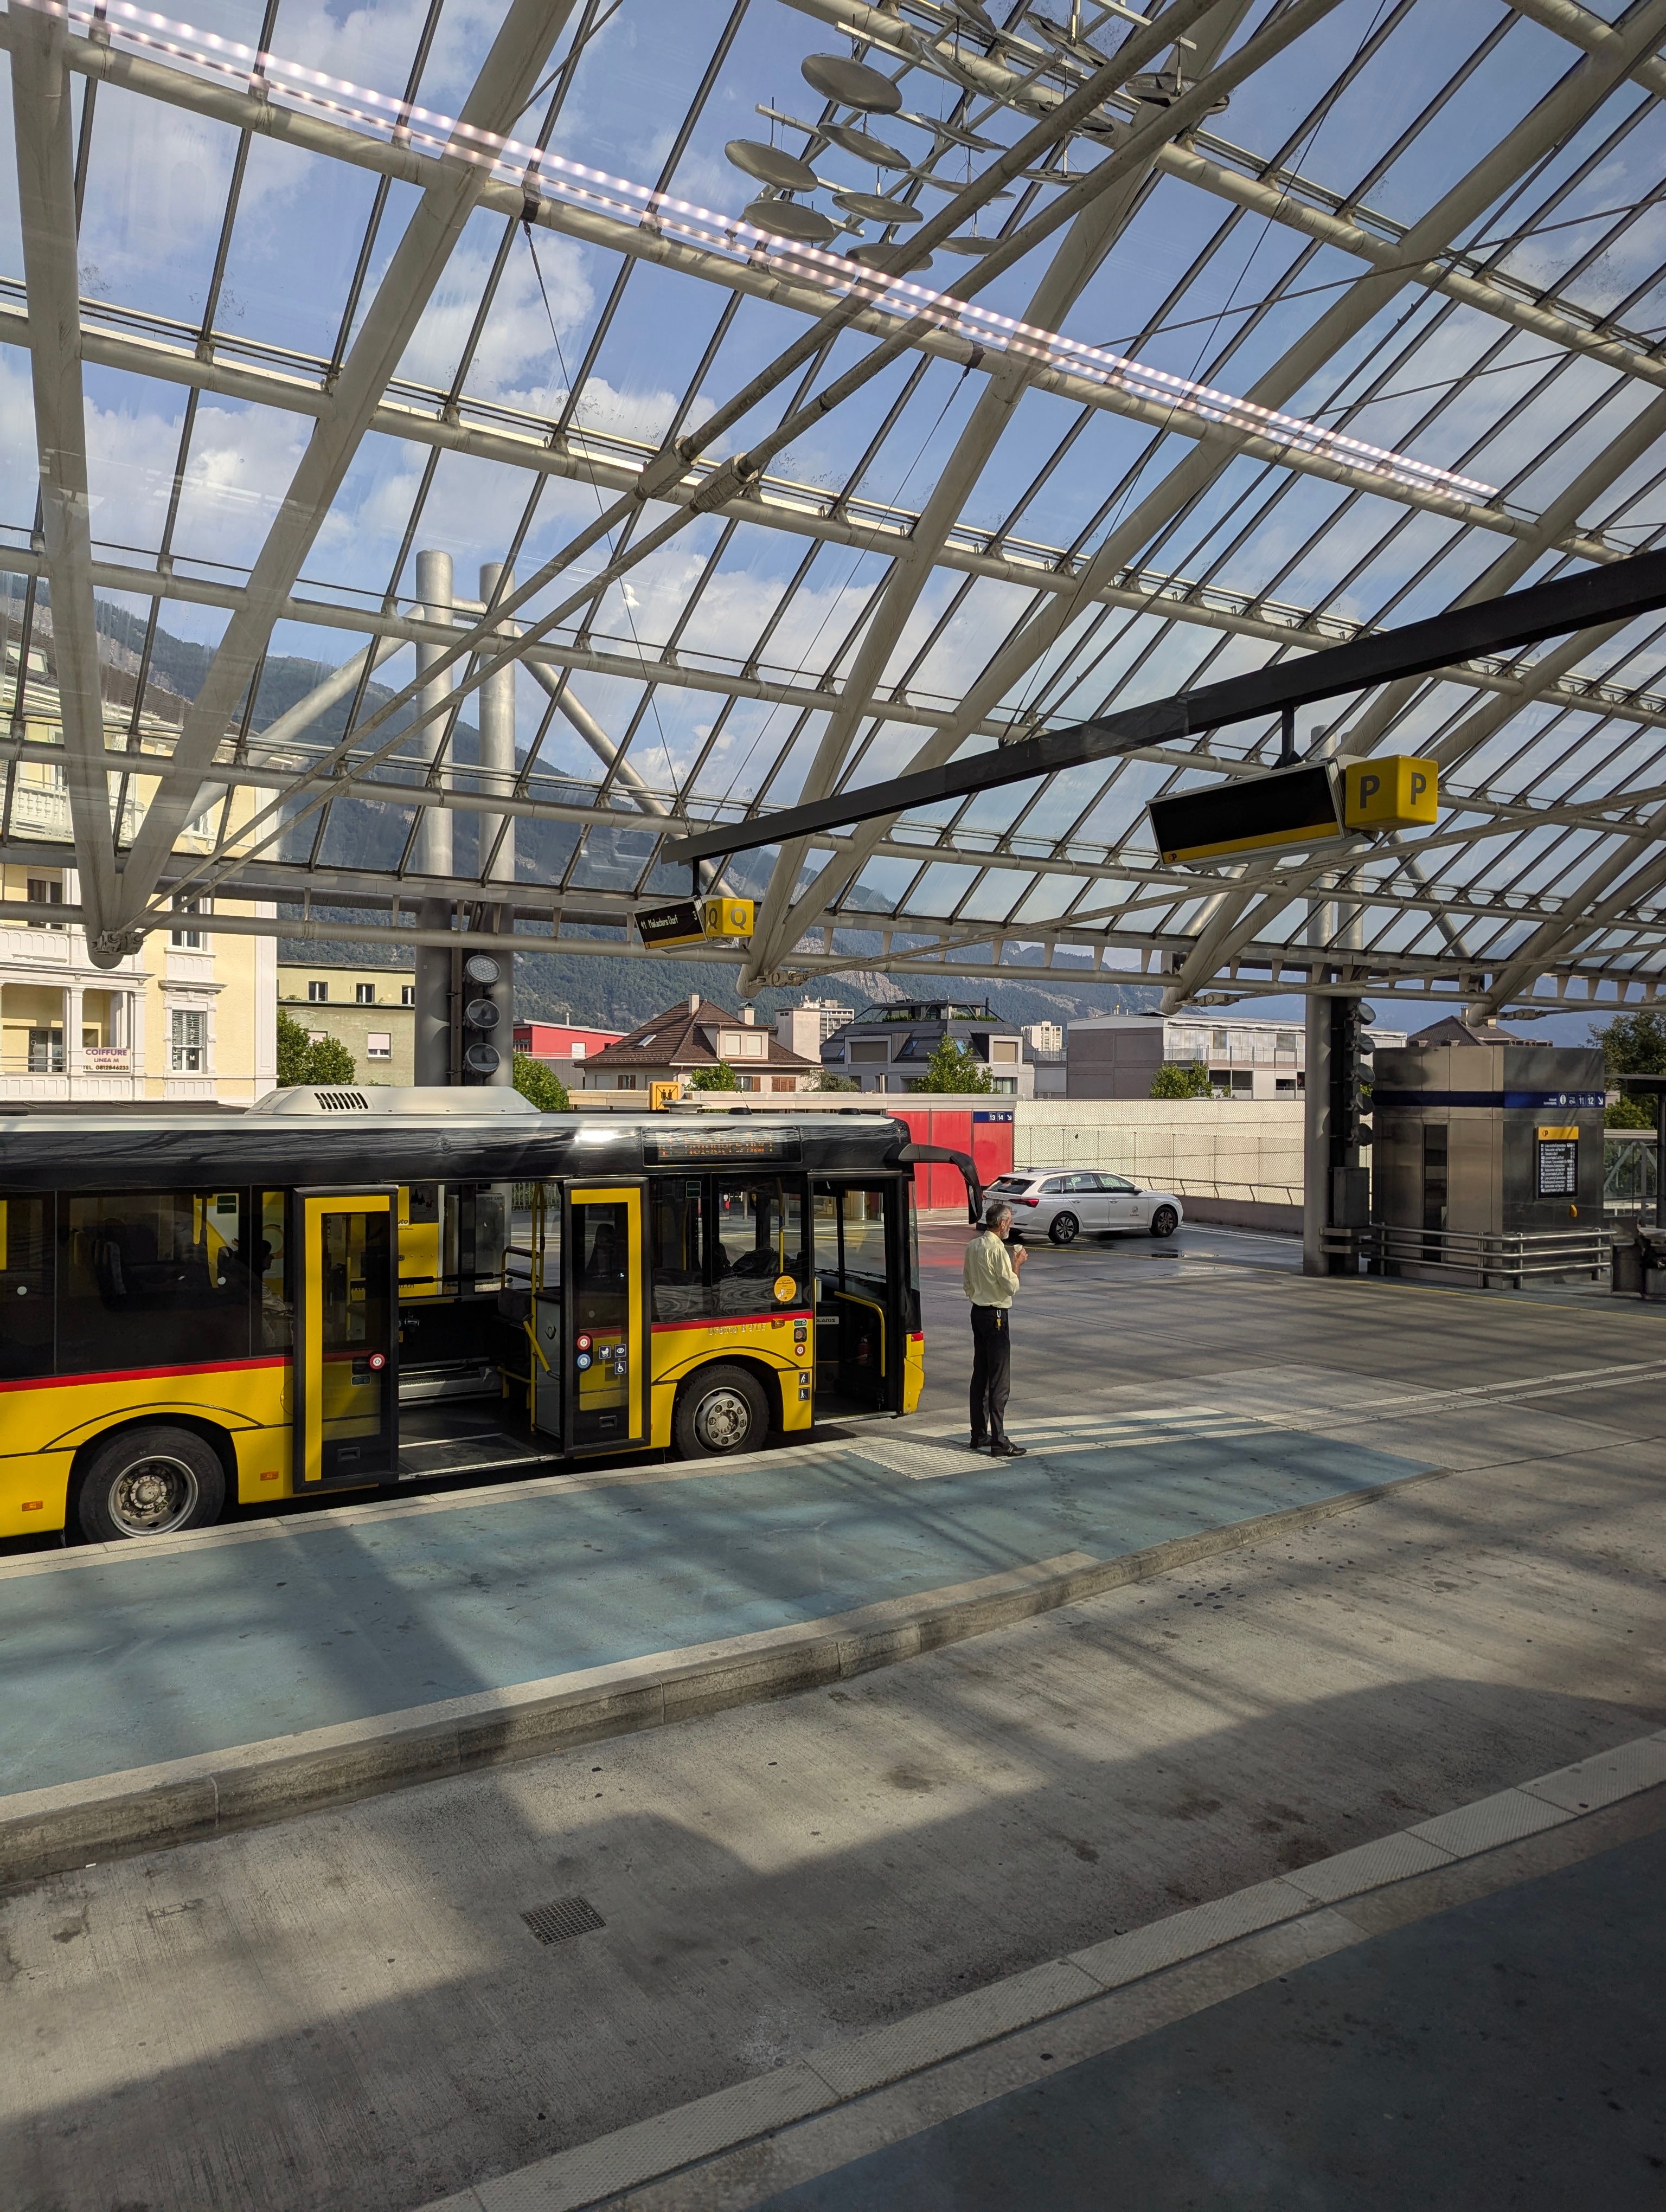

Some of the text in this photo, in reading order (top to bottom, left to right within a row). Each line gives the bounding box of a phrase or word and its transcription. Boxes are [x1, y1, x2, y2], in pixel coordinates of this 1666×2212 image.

[1360, 775, 1380, 809] P
[1411, 772, 1426, 805] P
[648, 917, 669, 928] Maladers
[667, 914, 678, 924] Dorf
[709, 907, 717, 929] Q
[731, 907, 746, 930] Q
[1579, 1096, 1594, 1105] 11 12
[756, 1323, 766, 1331] LE
